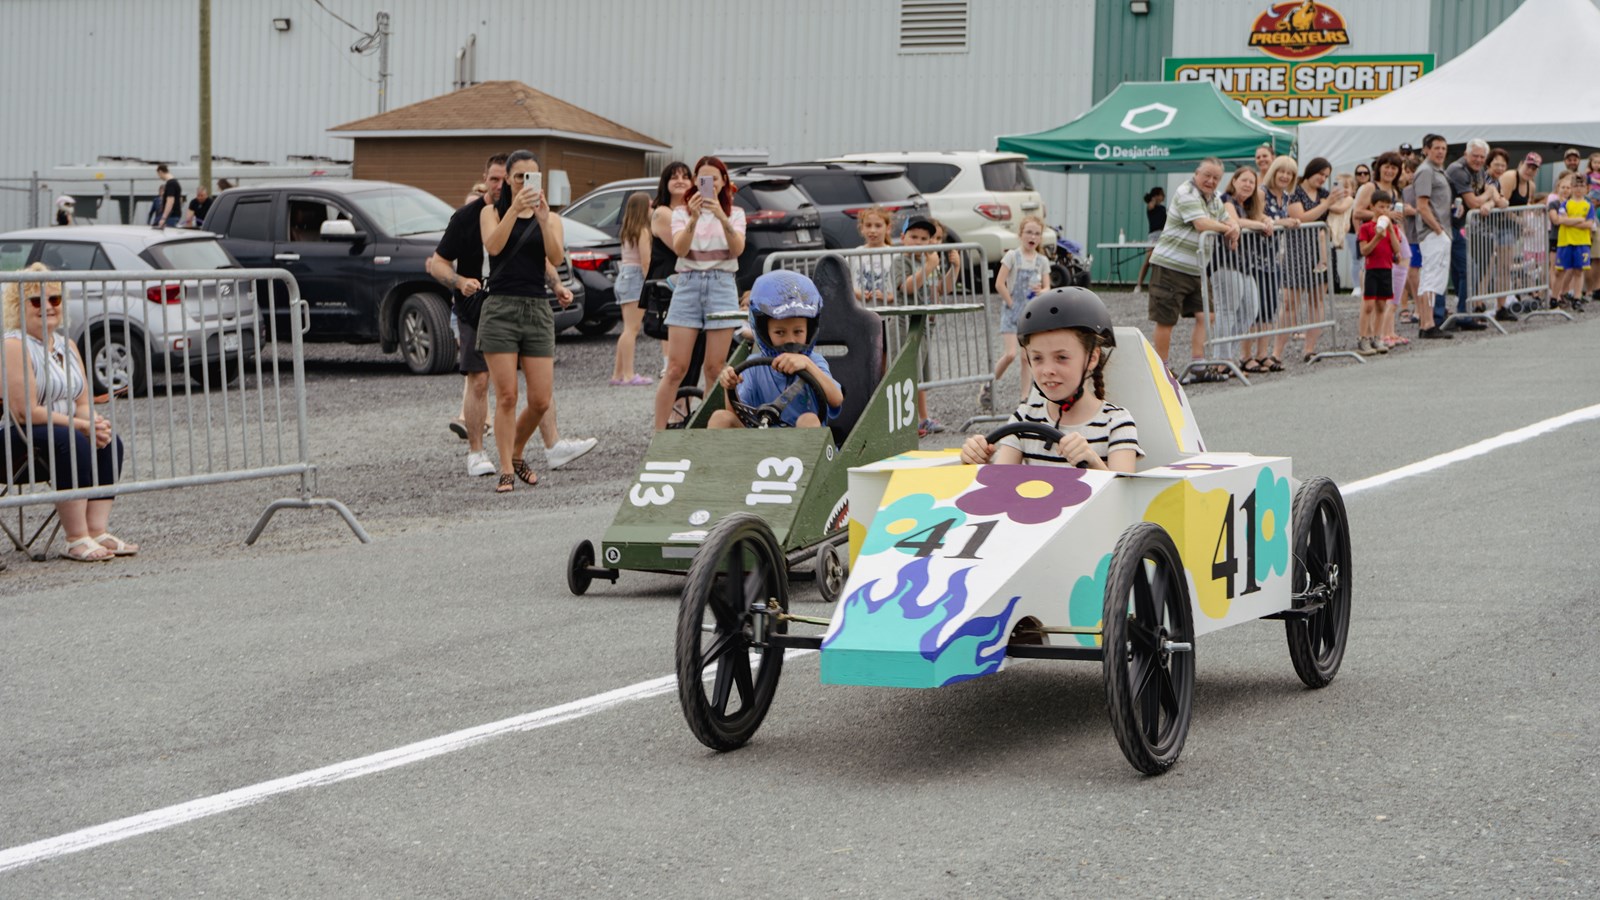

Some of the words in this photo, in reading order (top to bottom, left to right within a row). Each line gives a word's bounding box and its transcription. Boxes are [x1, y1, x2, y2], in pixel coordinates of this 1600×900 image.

[1235, 98, 1341, 118] ACINE
[1112, 145, 1170, 159] Desjardins
[886, 377, 915, 434] 113
[629, 458, 691, 507] 113
[745, 456, 804, 506] 113
[894, 518, 1000, 560] 41
[1211, 488, 1262, 600] 41
